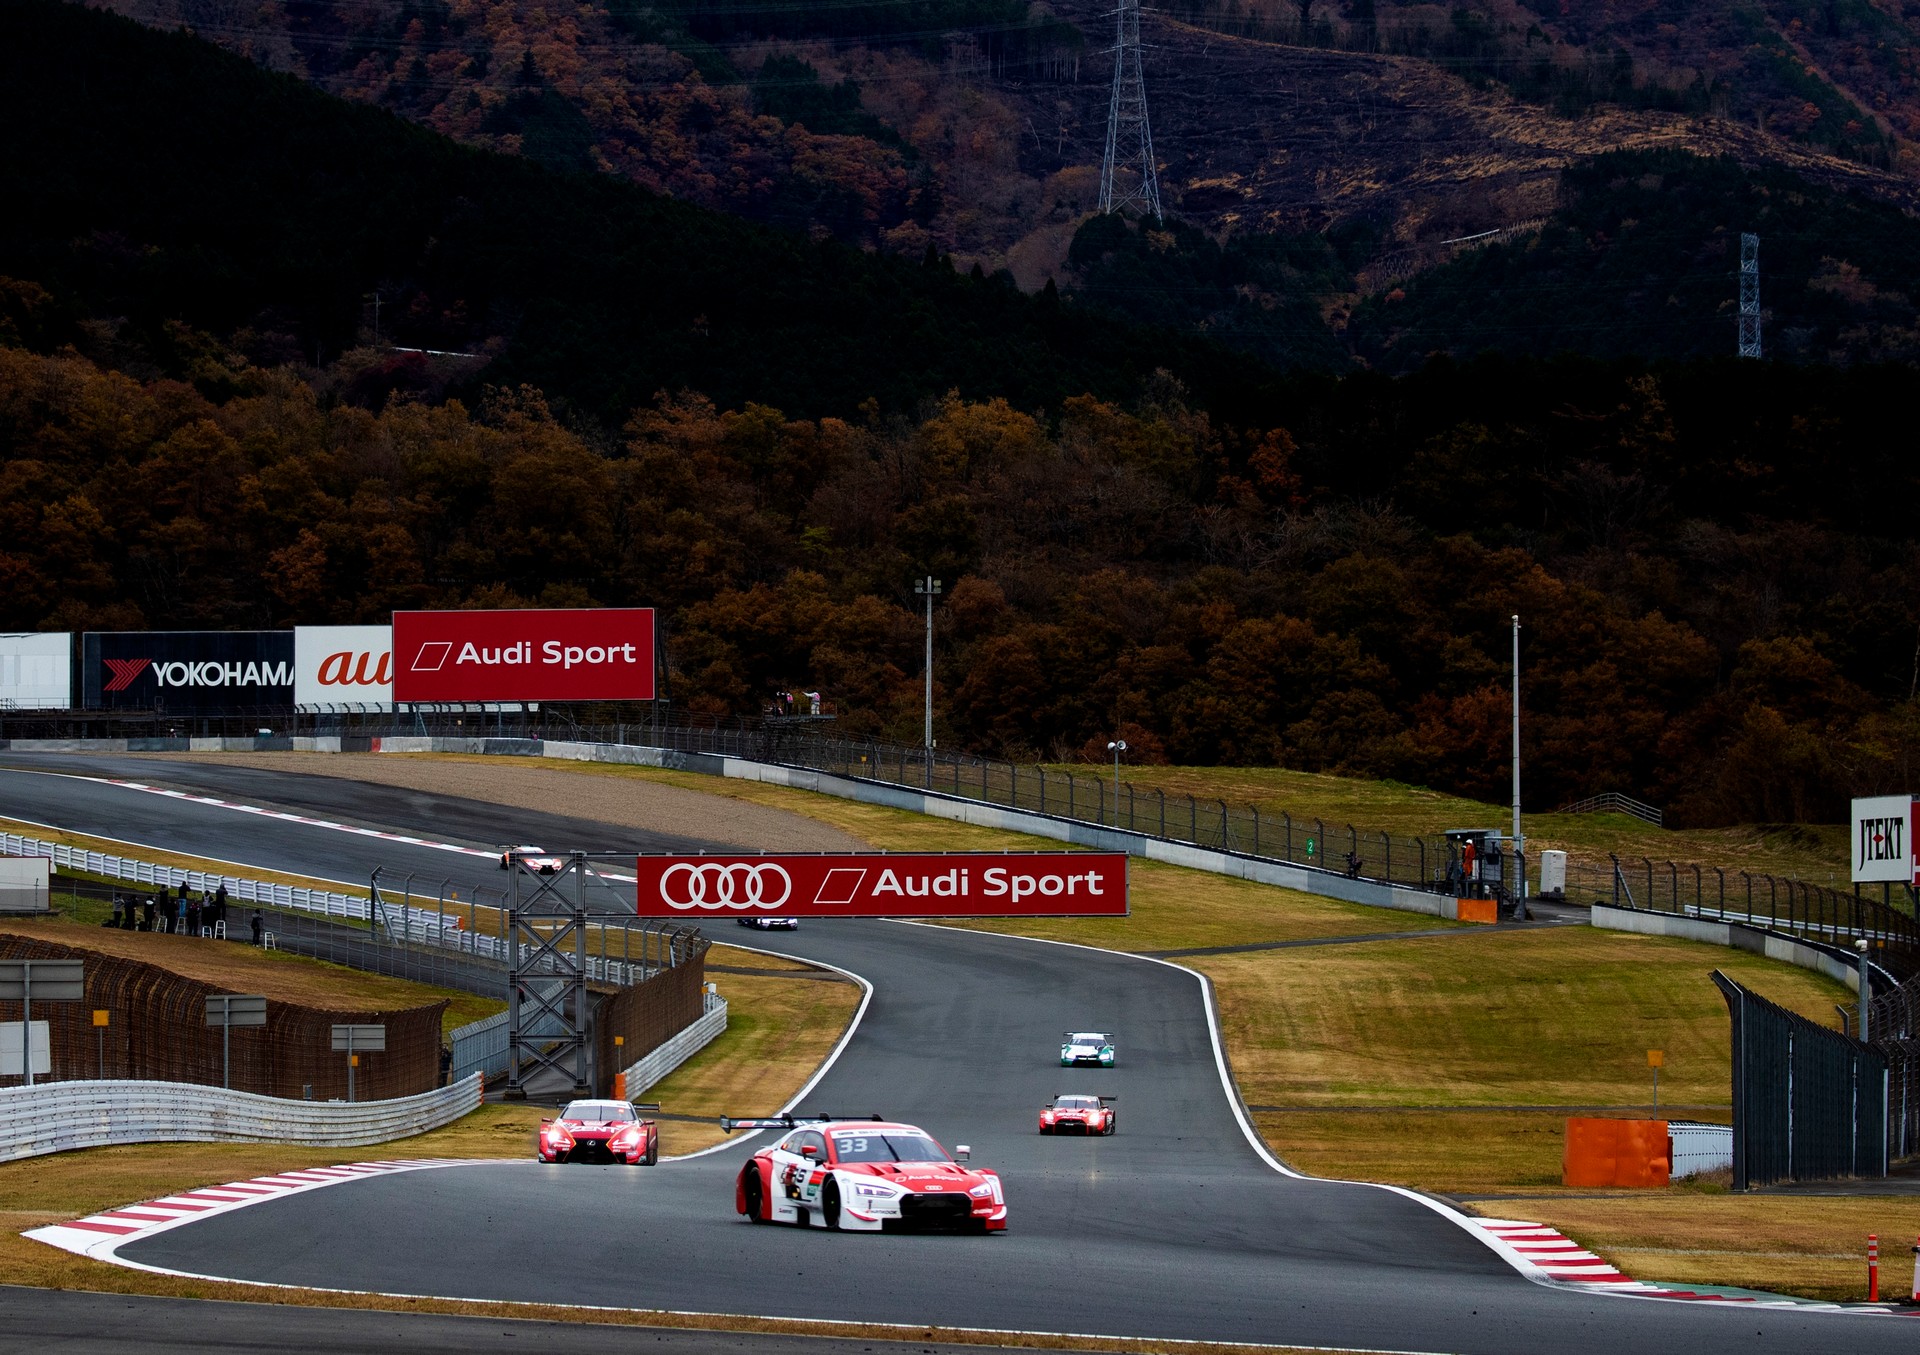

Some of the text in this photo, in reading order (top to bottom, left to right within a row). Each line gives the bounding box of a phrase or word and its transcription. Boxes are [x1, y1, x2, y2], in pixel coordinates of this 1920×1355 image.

[317, 651, 392, 686] au
[455, 640, 637, 669] Audi Sport
[1859, 816, 1904, 871] JTEKT
[871, 867, 1104, 903] Audi Sport
[839, 1137, 868, 1154] 33
